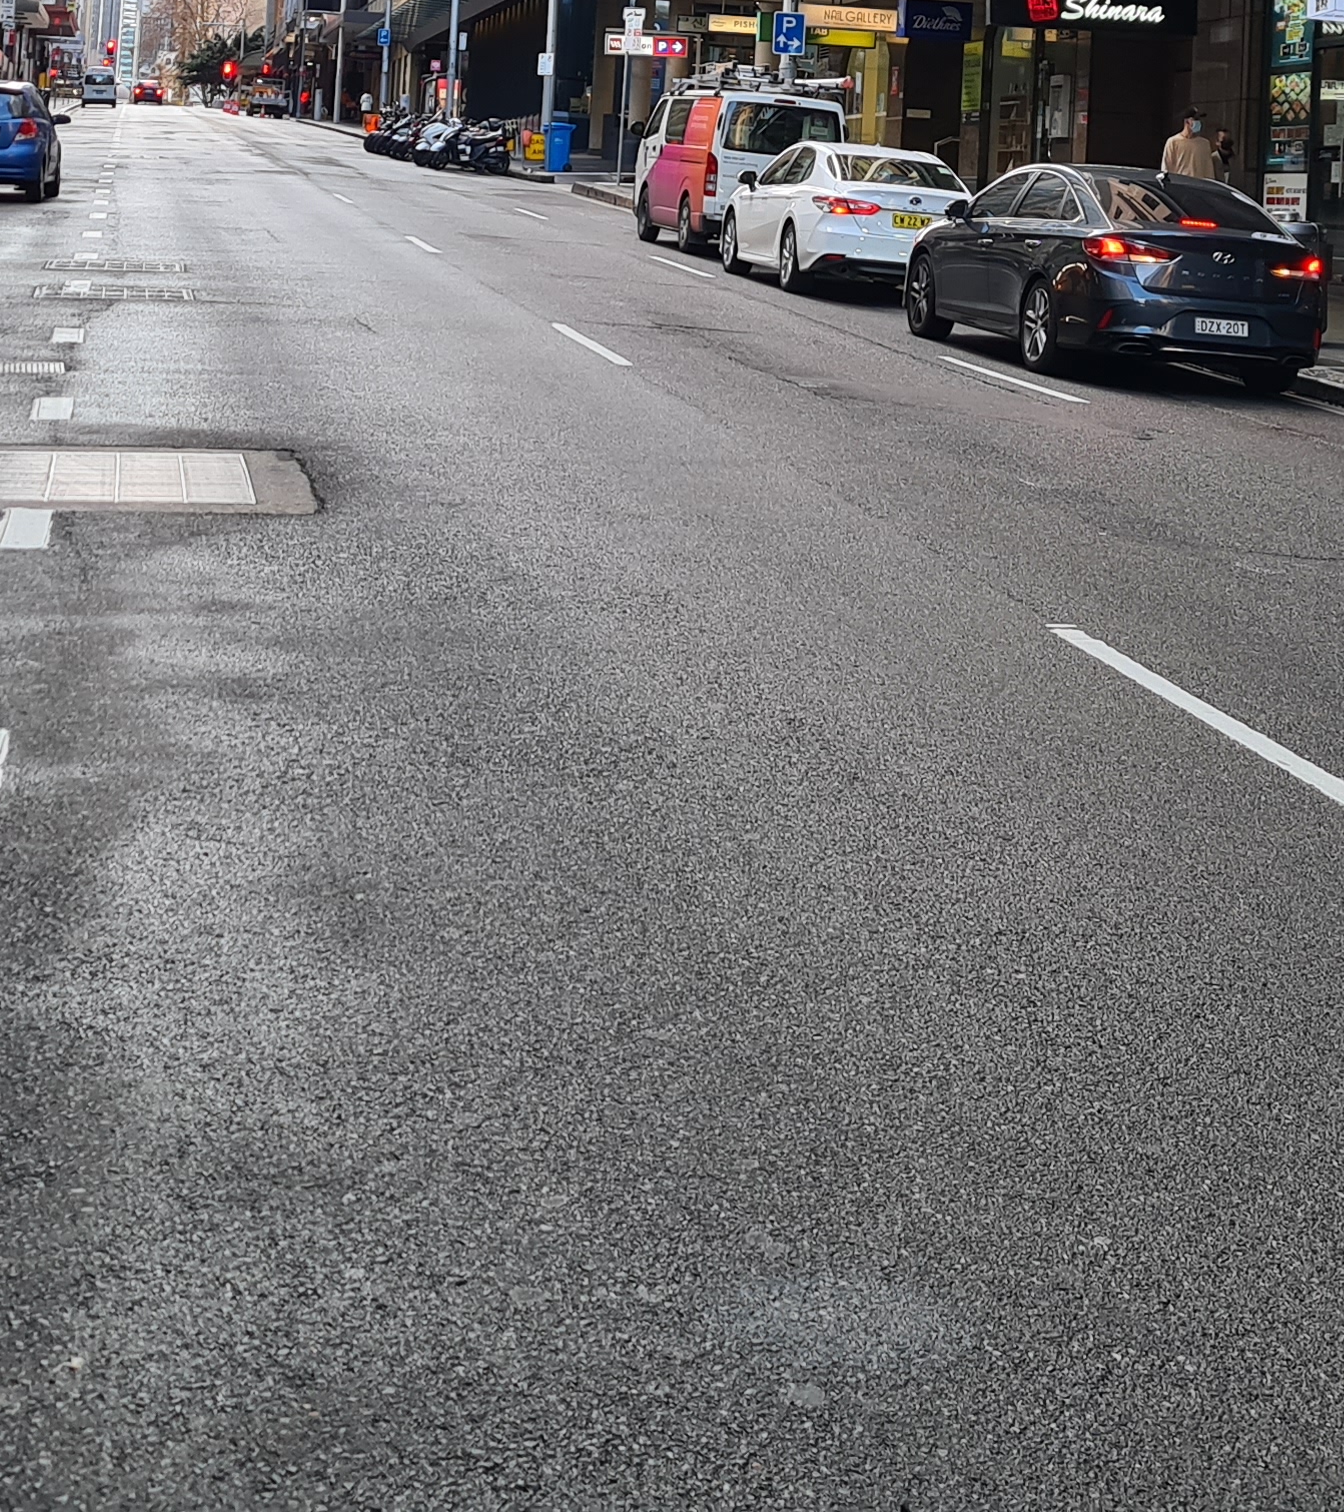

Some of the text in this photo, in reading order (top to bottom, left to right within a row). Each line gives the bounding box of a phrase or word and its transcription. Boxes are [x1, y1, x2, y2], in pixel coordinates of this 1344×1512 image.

[783, 16, 797, 33] P
[845, 10, 893, 25] GALLERY
[658, 41, 668, 52] P
